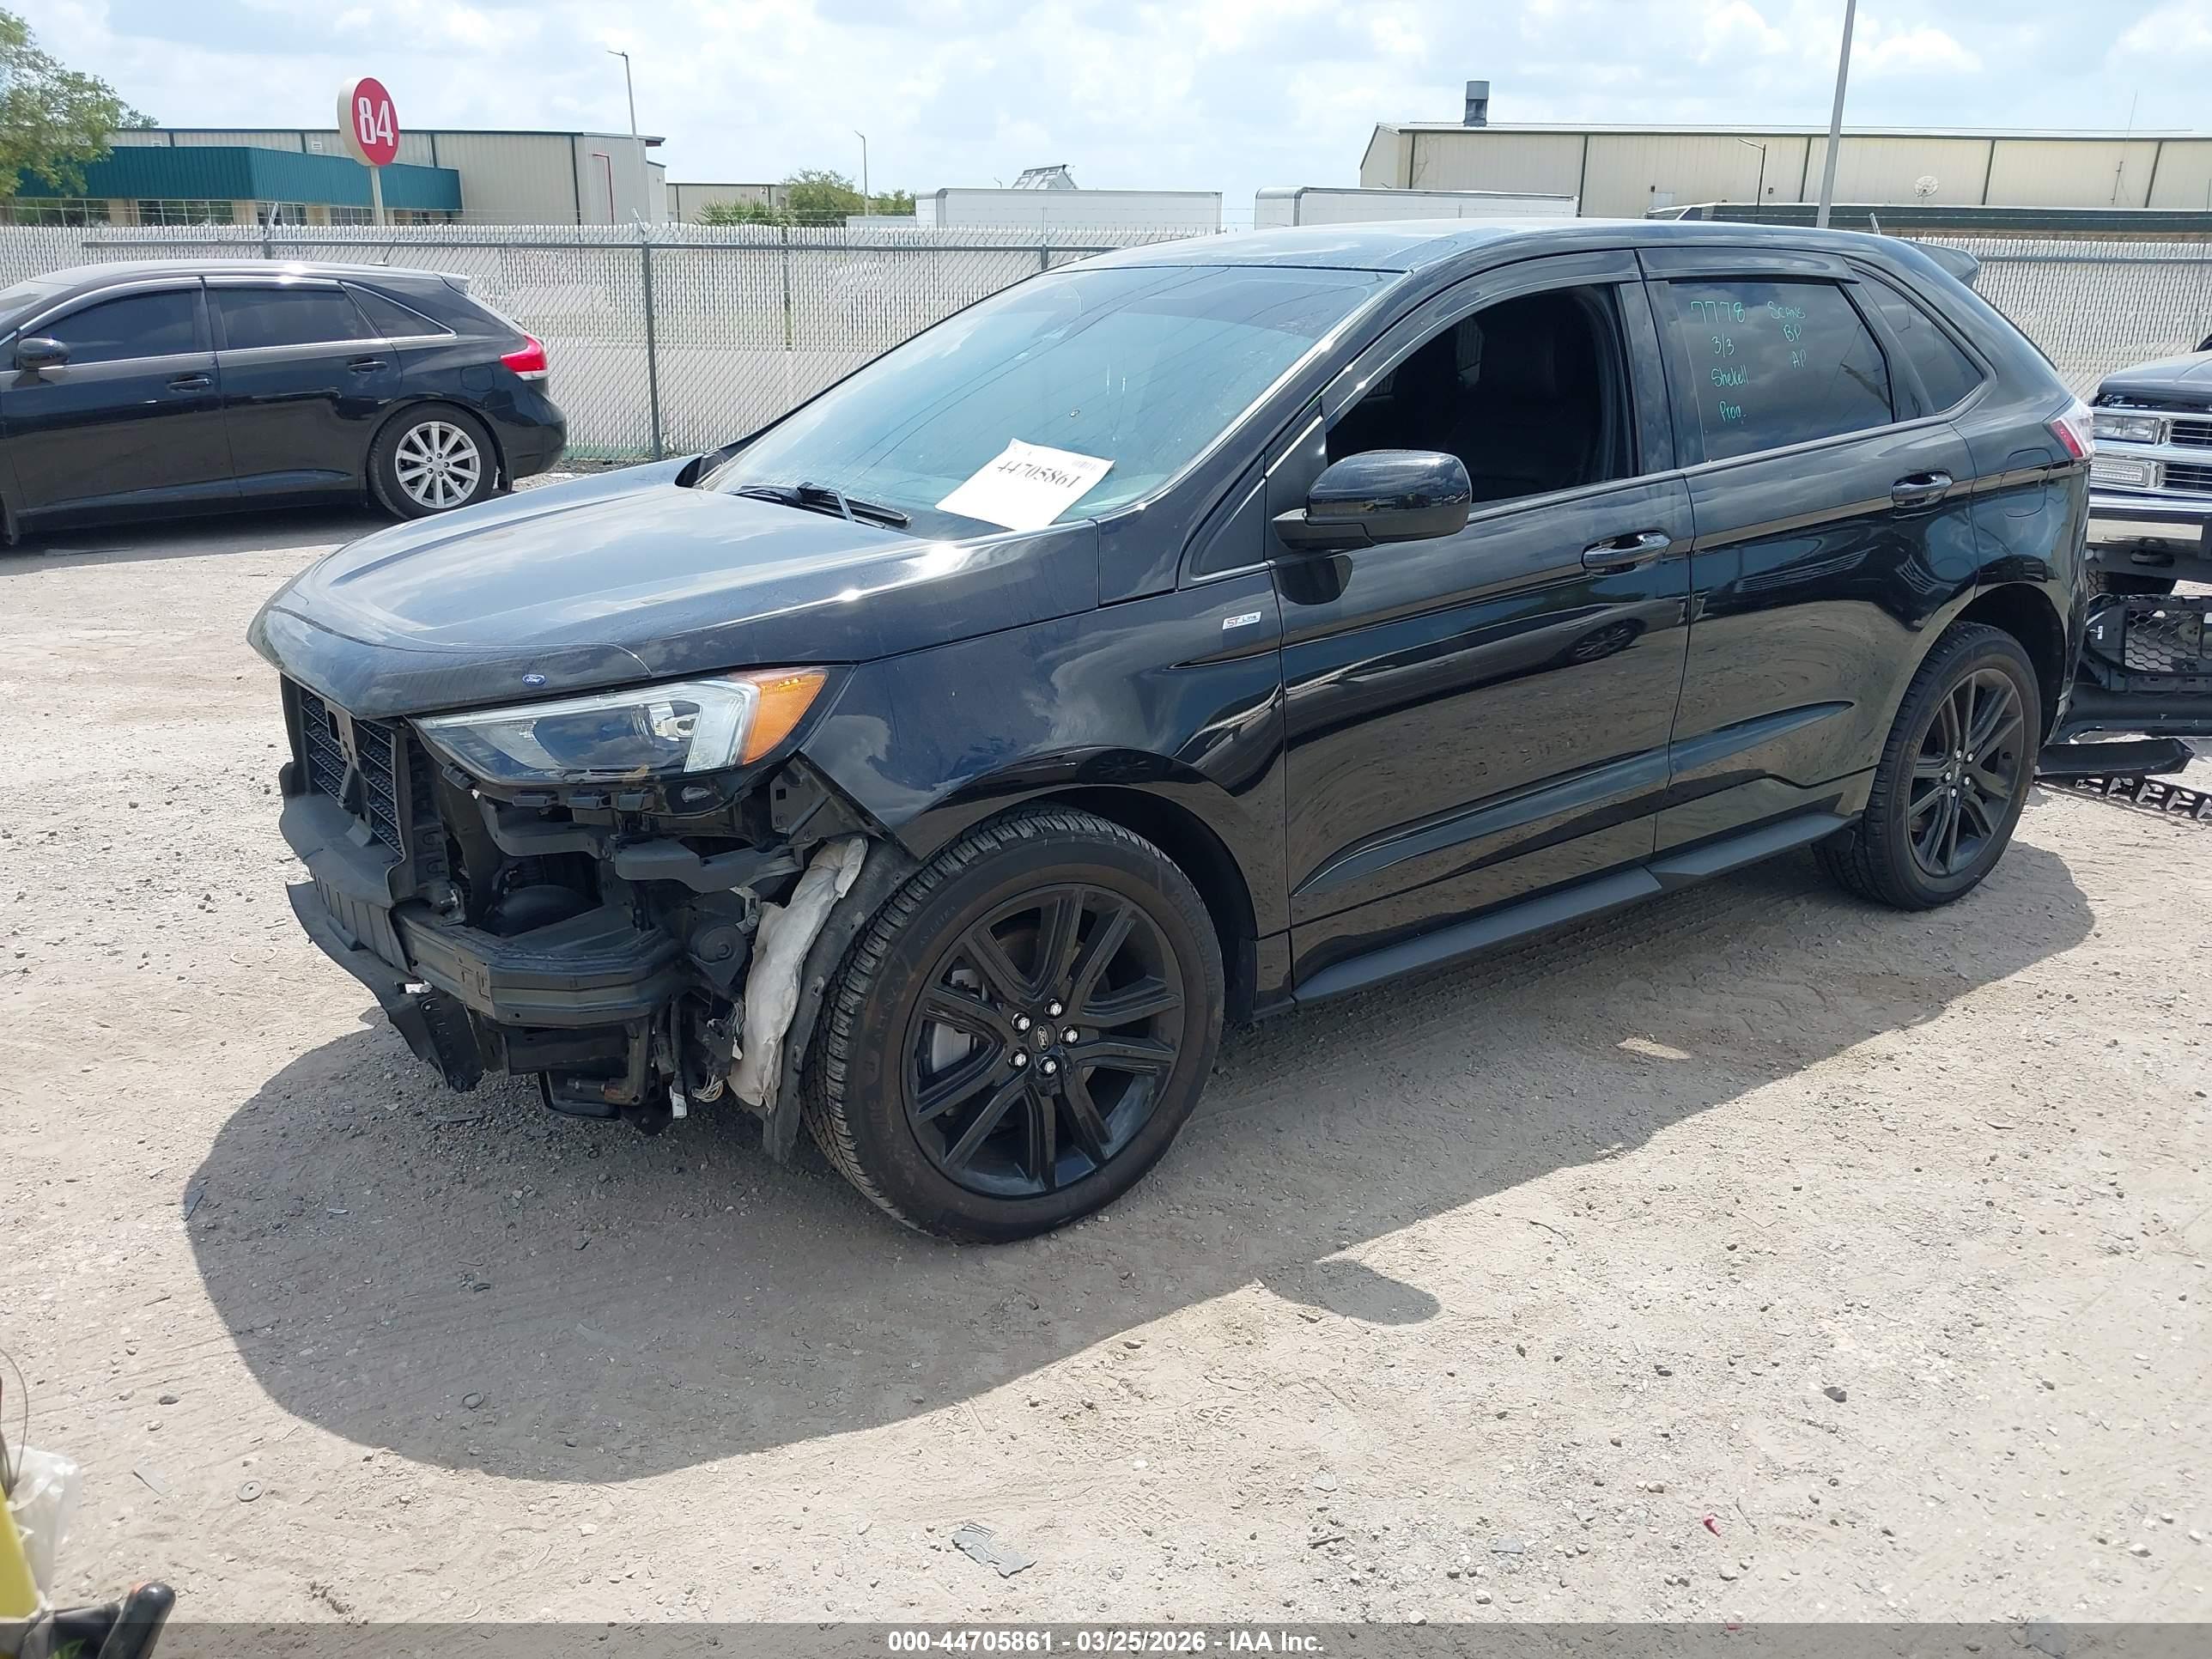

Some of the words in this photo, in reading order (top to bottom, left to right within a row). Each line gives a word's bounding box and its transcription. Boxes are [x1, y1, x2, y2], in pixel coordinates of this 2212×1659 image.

[358, 96, 394, 147] 84
[1690, 301, 1746, 324] 7778
[1711, 331, 1735, 357] 3/3
[998, 460, 1081, 487] 44705861
